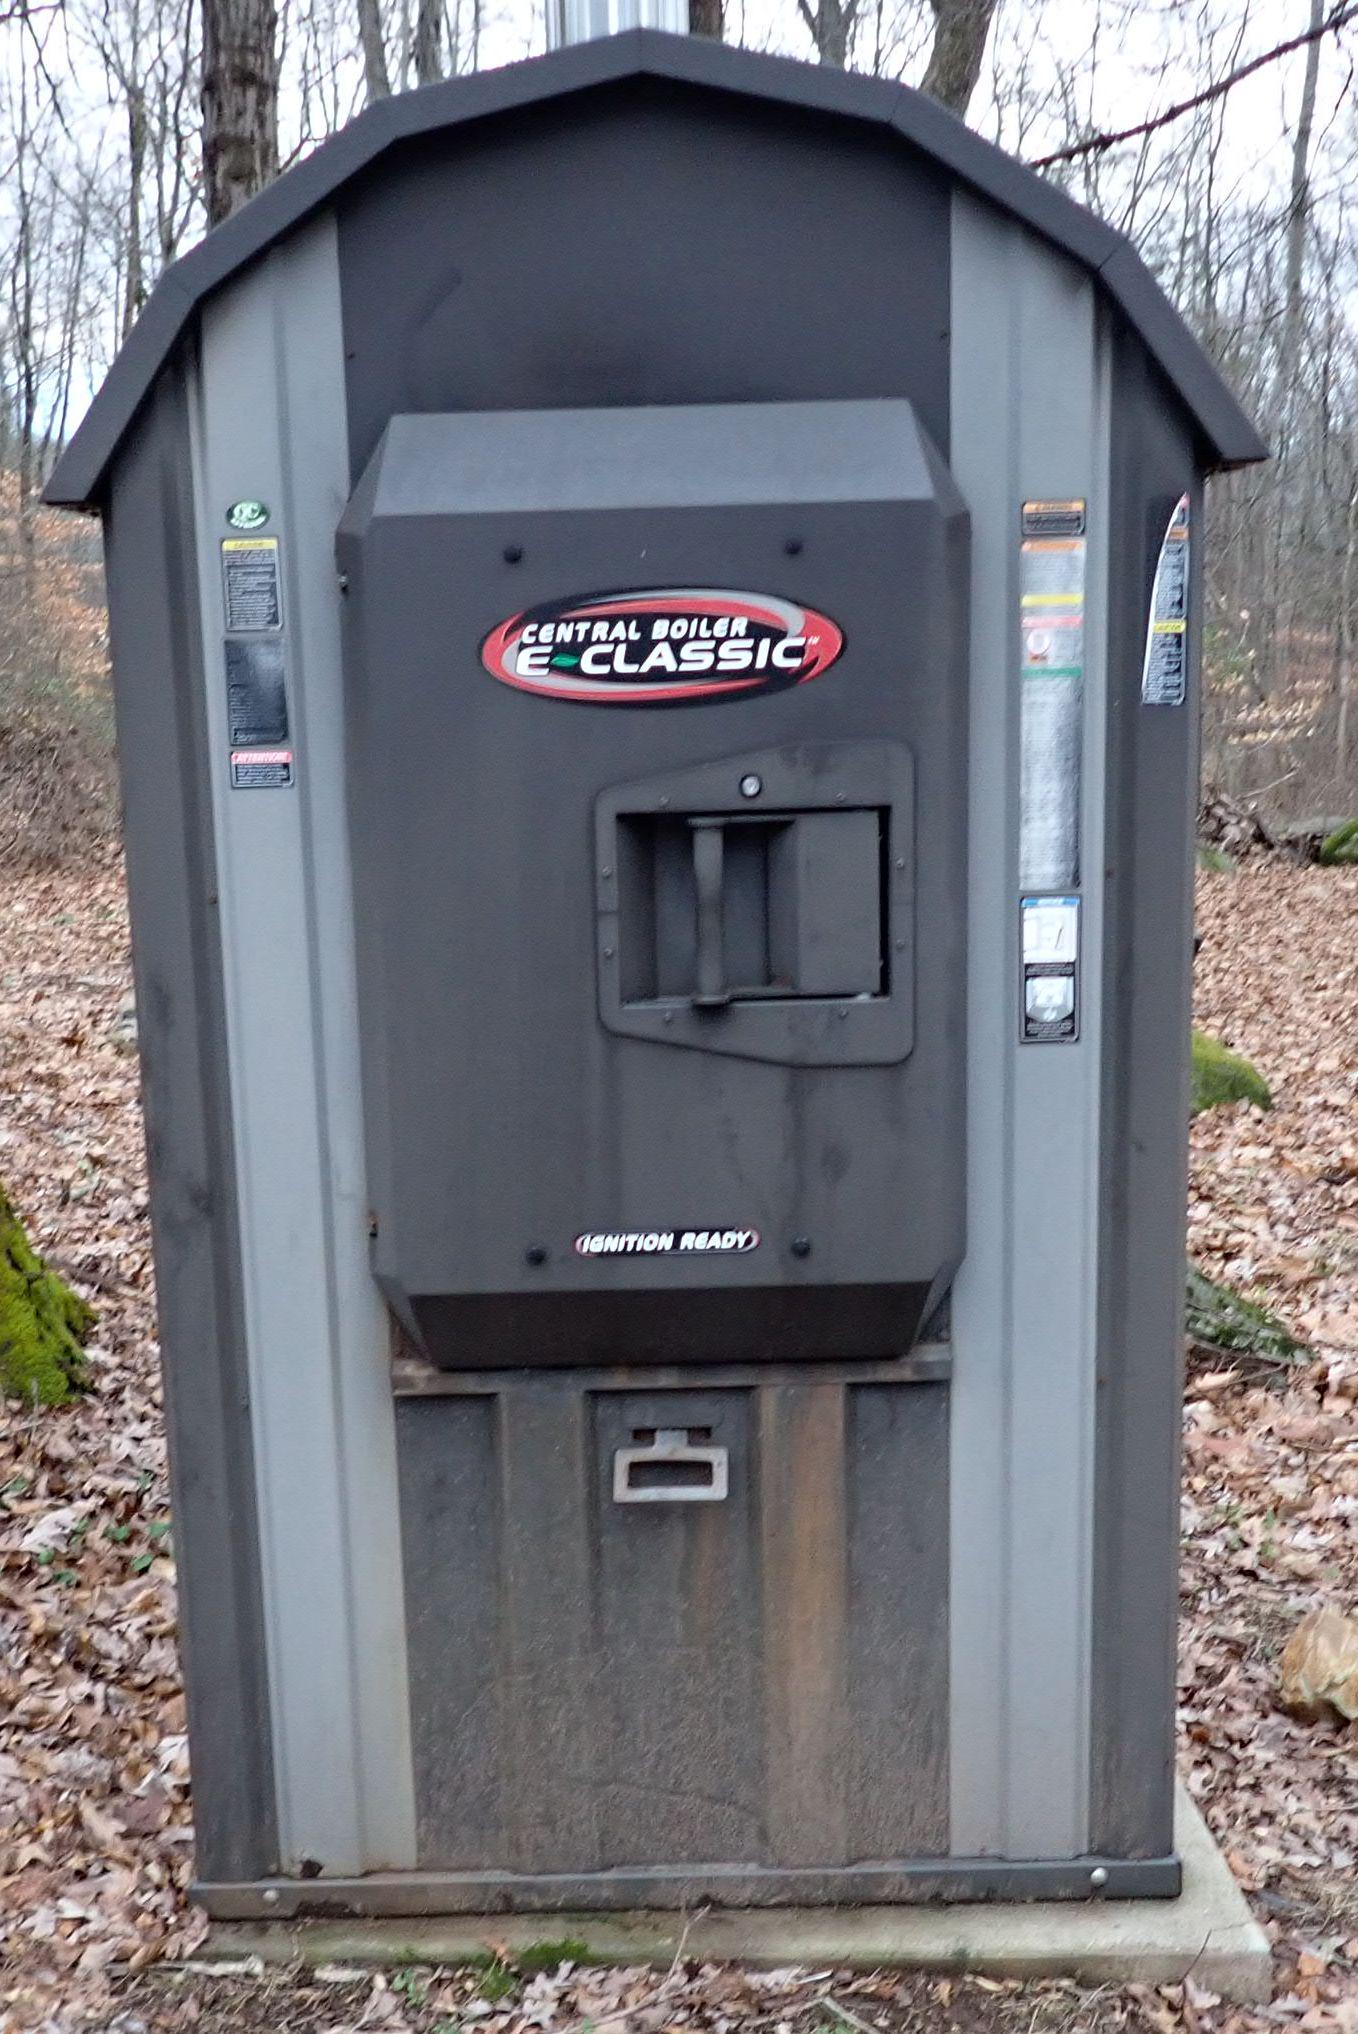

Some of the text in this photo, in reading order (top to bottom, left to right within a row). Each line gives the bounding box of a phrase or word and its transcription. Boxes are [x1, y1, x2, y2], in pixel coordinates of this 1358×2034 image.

[521, 616, 748, 644] CENTRAL BOILER
[582, 1230, 752, 1252] IGNITION READY
